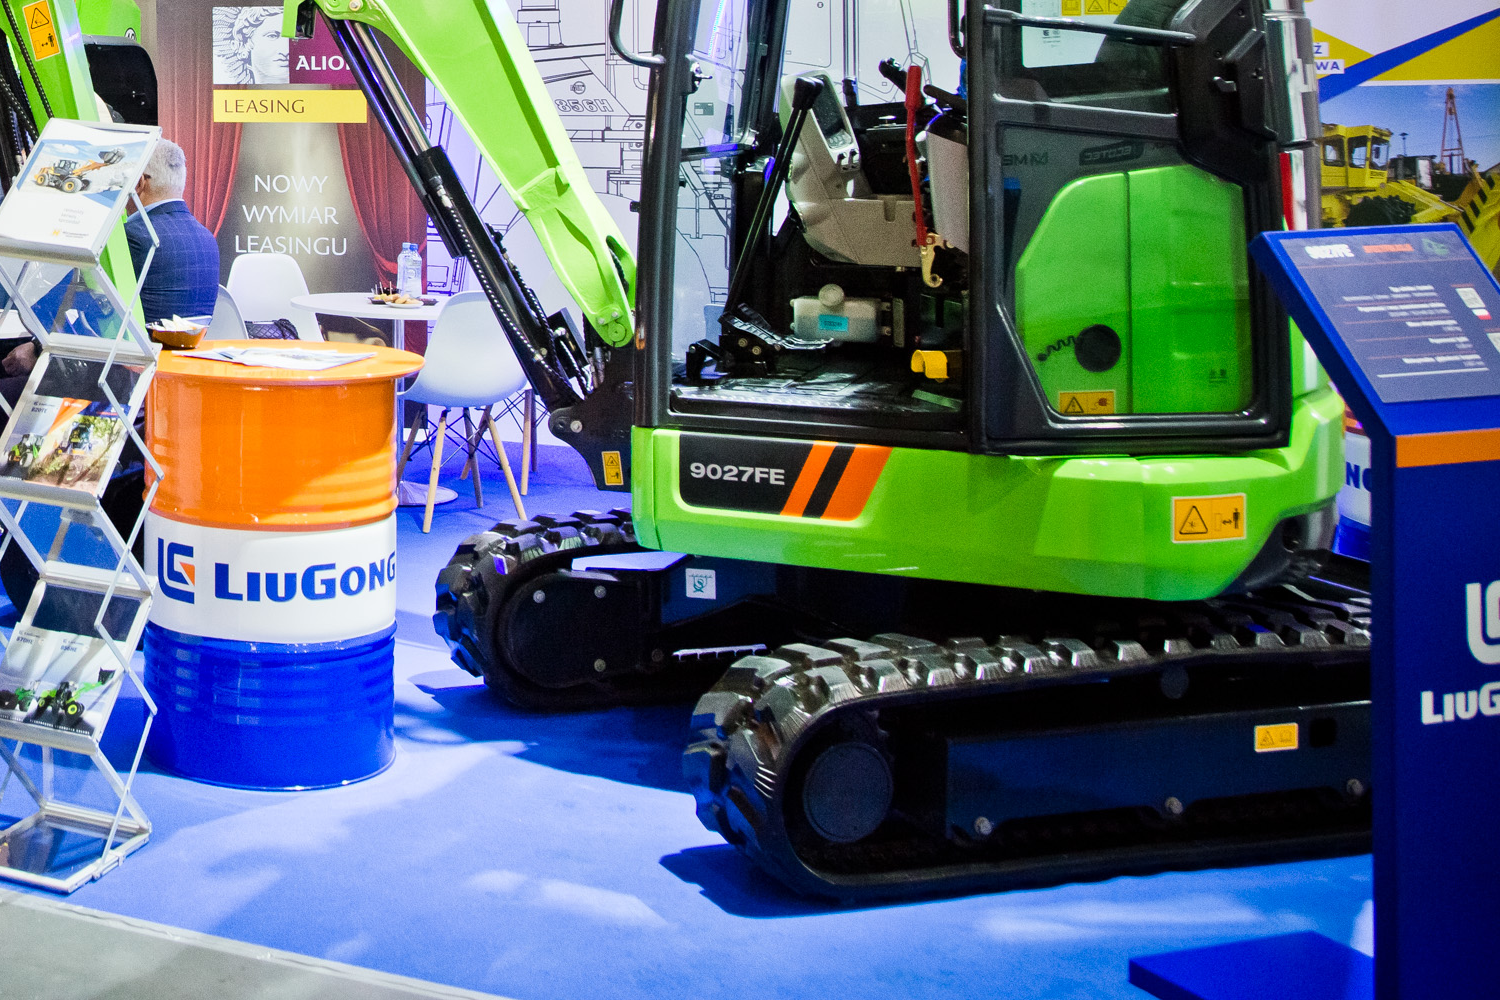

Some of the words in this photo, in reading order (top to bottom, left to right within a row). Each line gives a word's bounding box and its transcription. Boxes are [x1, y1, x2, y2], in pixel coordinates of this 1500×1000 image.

[295, 55, 350, 71] ALIO
[224, 99, 305, 114] LEASING
[554, 98, 615, 113] 856H
[254, 174, 329, 194] NOWY
[241, 204, 340, 225] WYMIAR
[235, 234, 347, 256] LEASINGU
[690, 462, 786, 486] 9027FE
